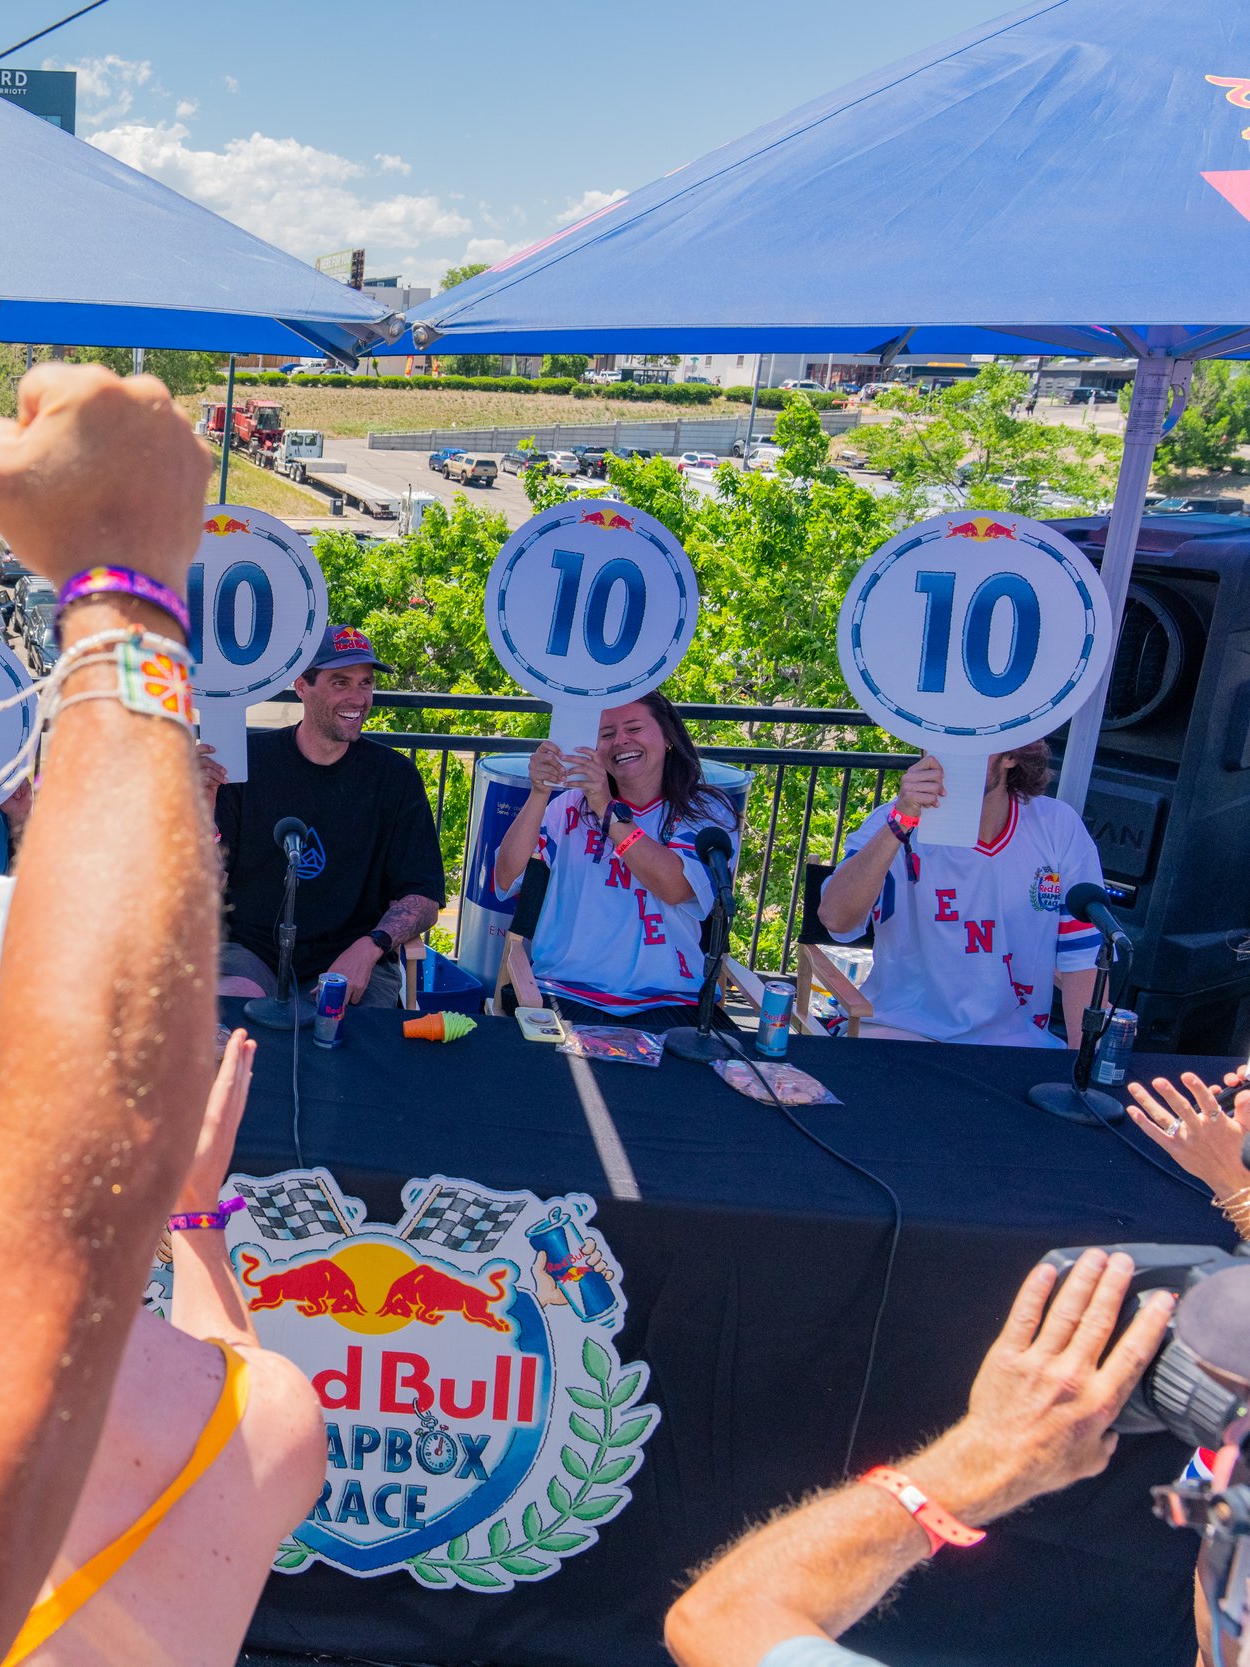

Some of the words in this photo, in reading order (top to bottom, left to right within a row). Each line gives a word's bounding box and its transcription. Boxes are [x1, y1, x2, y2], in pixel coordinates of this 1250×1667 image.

[187, 560, 274, 666] 10
[546, 549, 646, 666] 10
[914, 570, 1041, 698] 10
[1039, 884, 1054, 893] Red
[325, 1004, 344, 1015] Red
[763, 1009, 781, 1021] Red
[566, 1246, 587, 1265] Bul
[379, 1350, 538, 1424] Bull
[323, 1421, 492, 1482] APBOX
